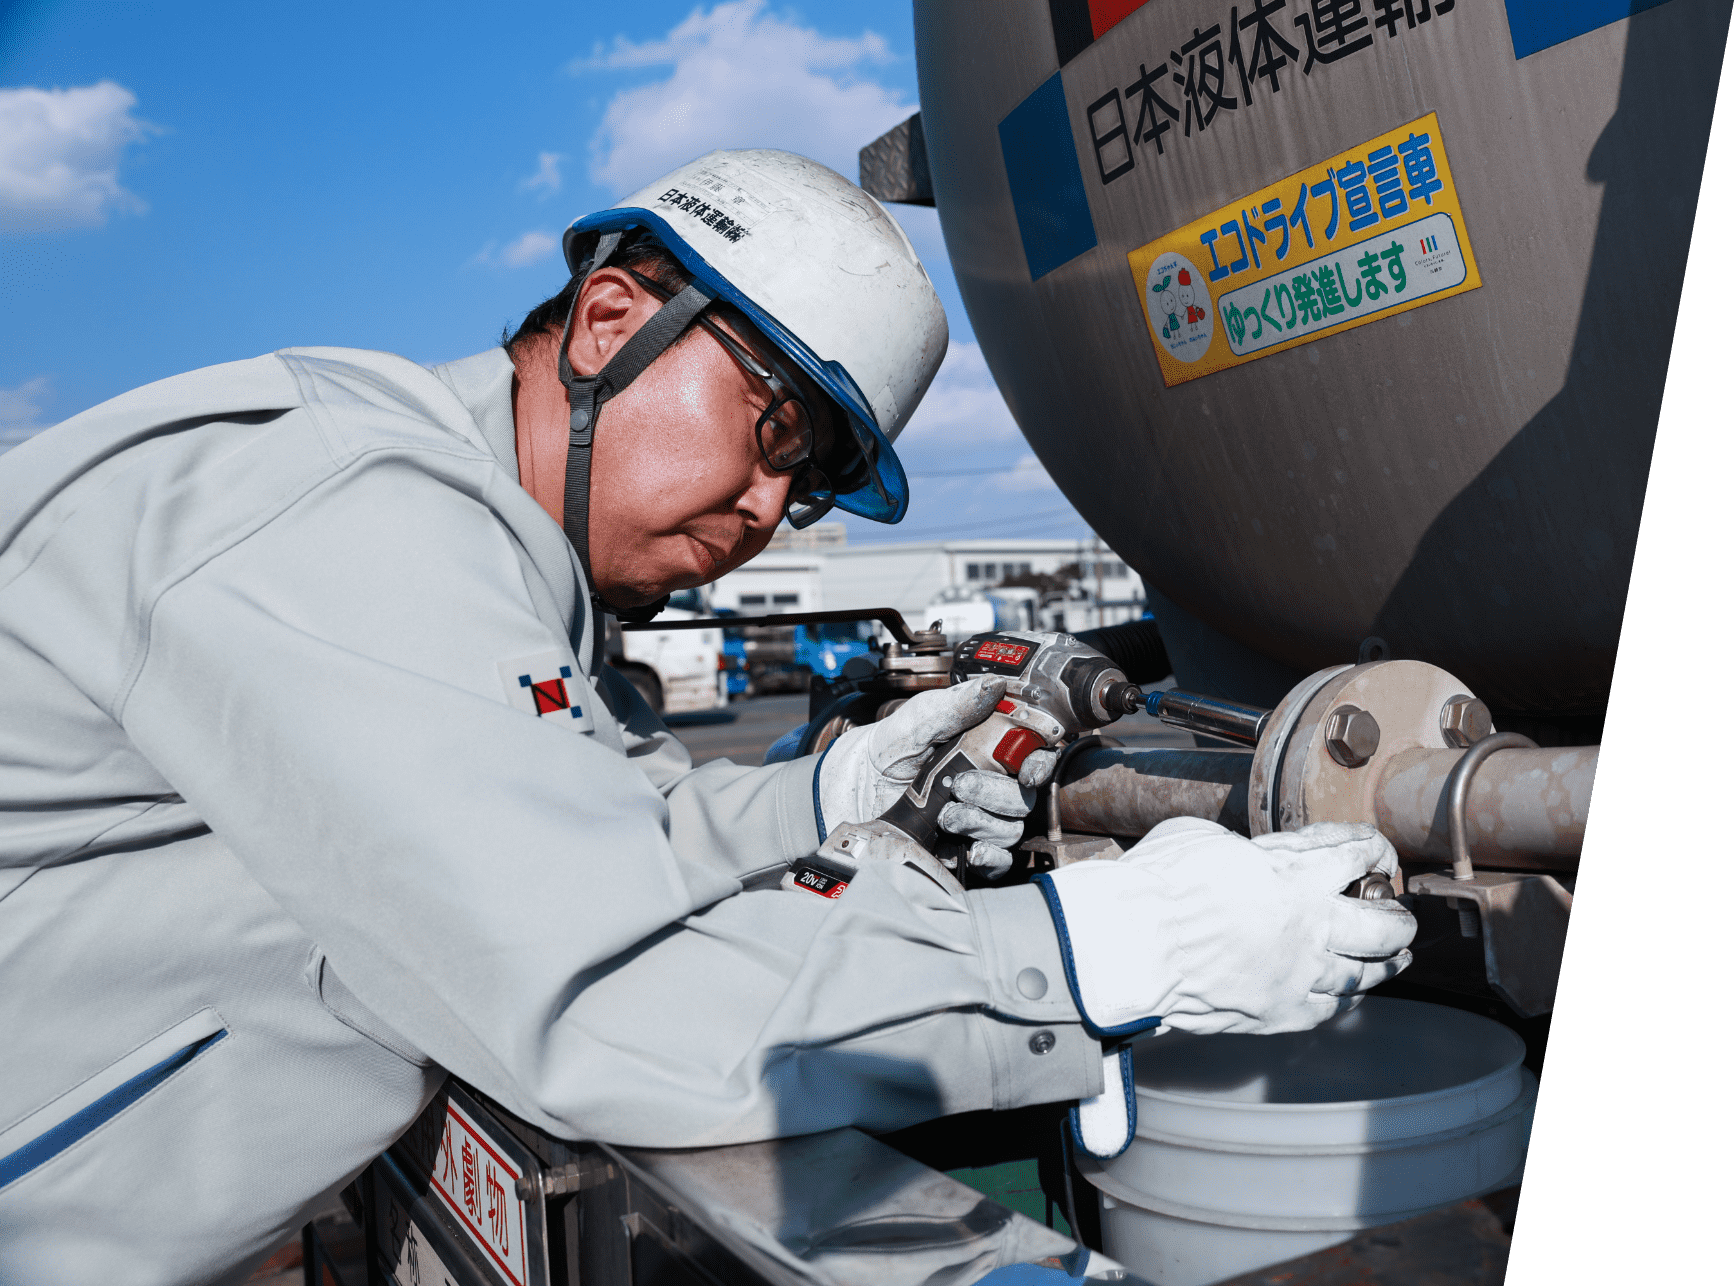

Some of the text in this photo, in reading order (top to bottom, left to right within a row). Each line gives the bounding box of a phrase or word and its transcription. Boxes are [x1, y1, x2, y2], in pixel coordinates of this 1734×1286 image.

[1201, 132, 1443, 282] エコドライブ宣言車
[1222, 240, 1407, 346] ゆっくり発進します
